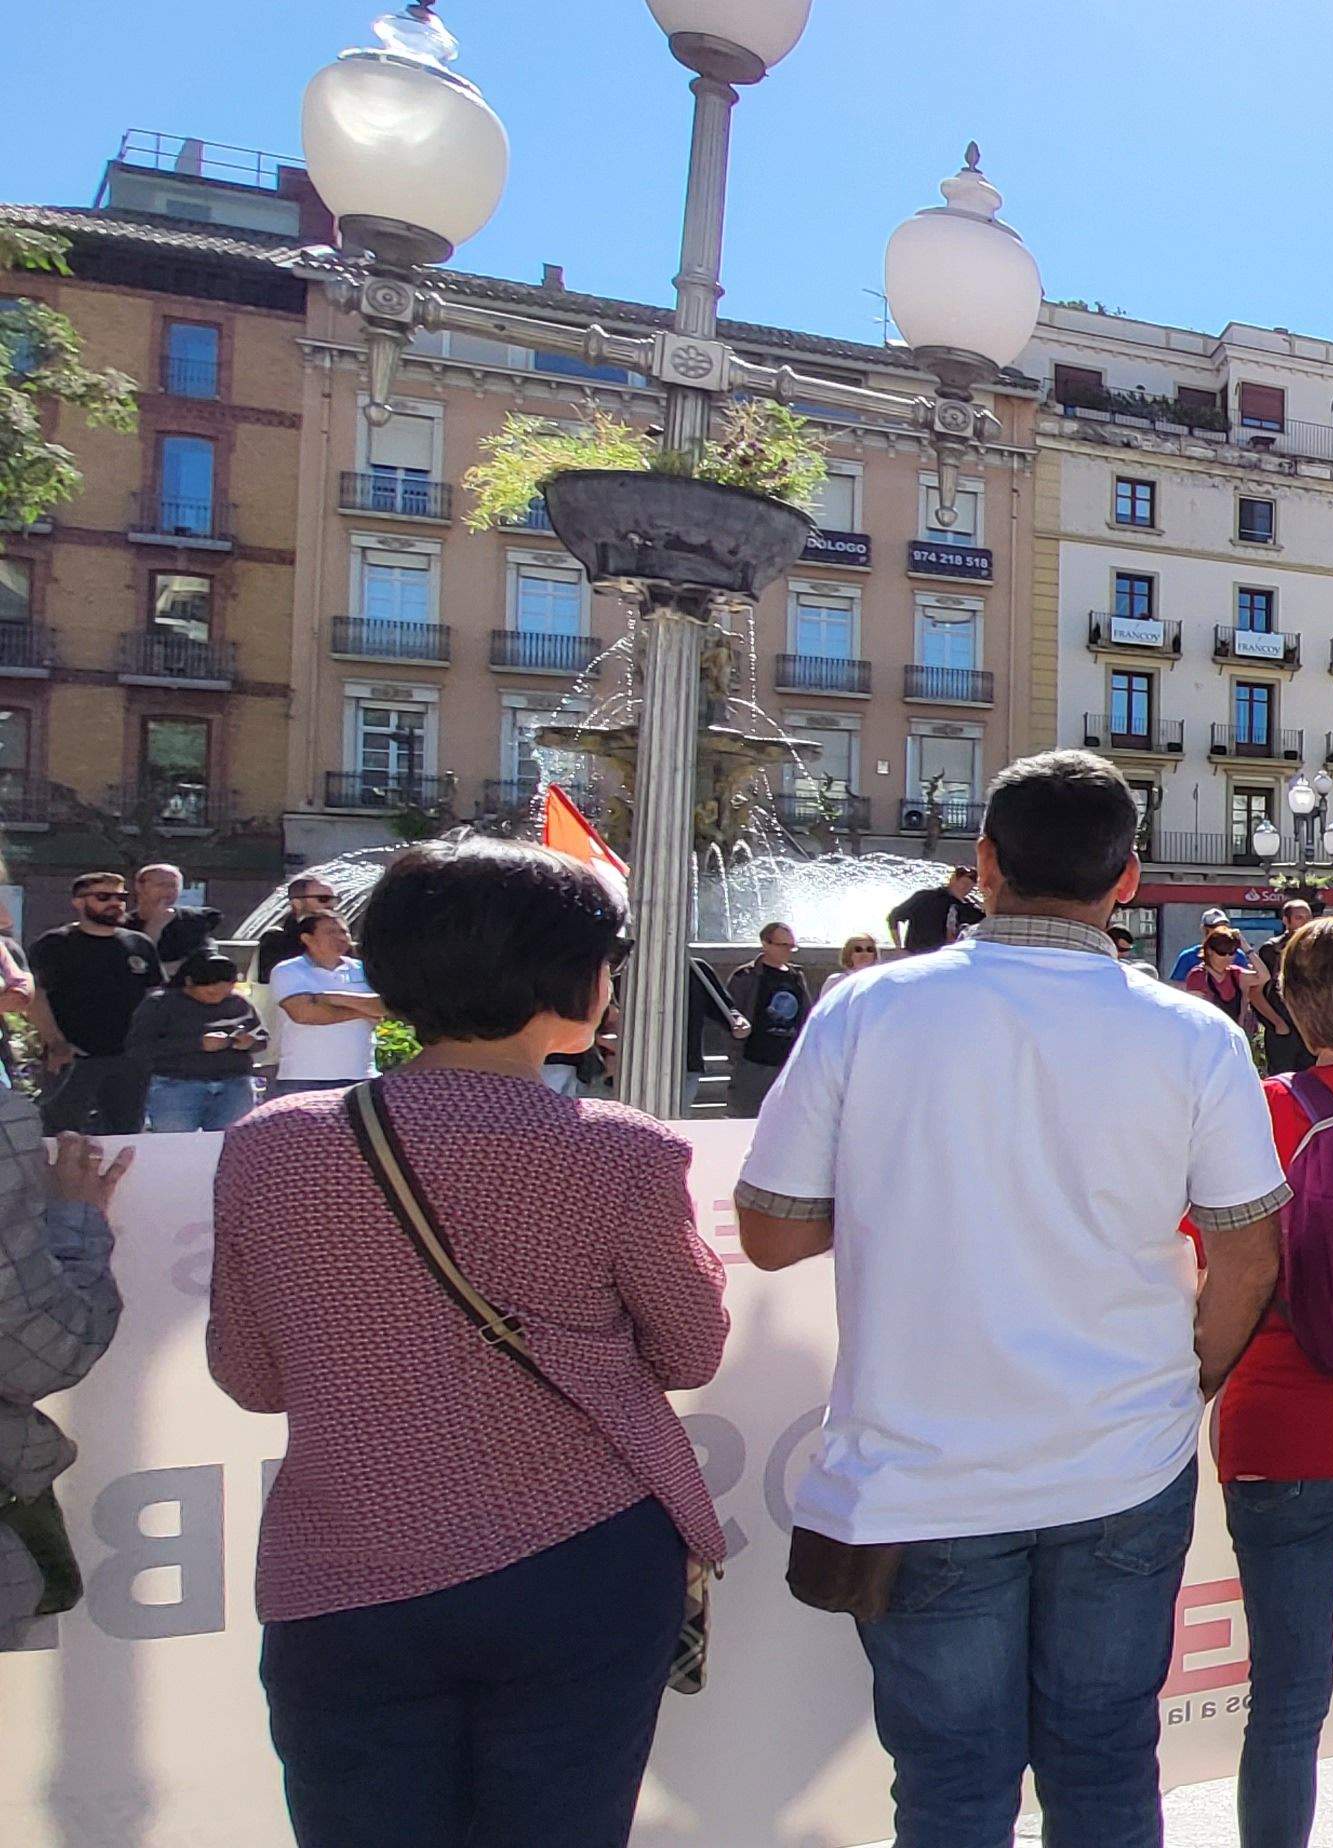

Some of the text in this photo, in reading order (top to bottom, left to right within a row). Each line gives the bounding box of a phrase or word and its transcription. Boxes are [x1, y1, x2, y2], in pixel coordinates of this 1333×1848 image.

[806, 537, 867, 554] DOLOGO
[913, 550, 988, 569] 974 218 518
[1262, 891, 1286, 901] San
